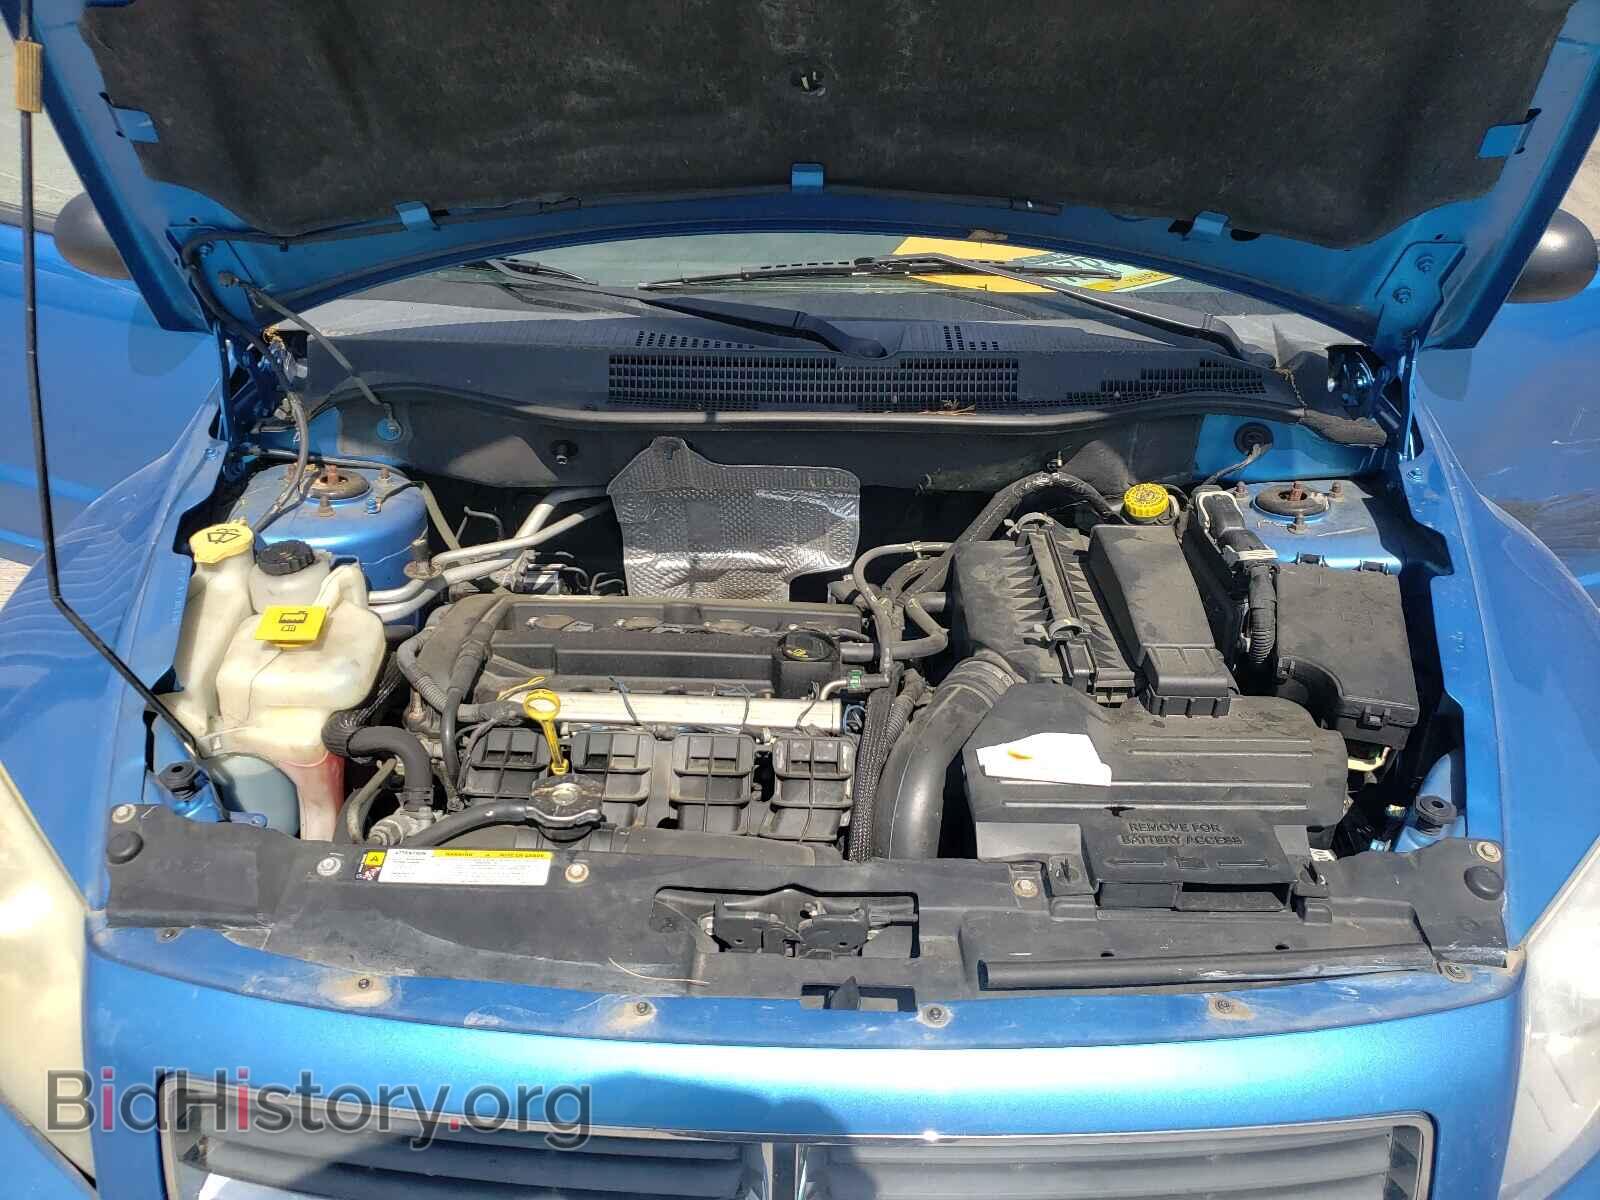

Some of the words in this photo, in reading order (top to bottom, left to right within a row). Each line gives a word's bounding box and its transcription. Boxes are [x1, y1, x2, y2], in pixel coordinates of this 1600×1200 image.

[1128, 822, 1189, 833] REMOVE
[1191, 822, 1224, 833] FOR
[1120, 834, 1181, 845] BATTERY
[1186, 834, 1242, 845] ACCESS
